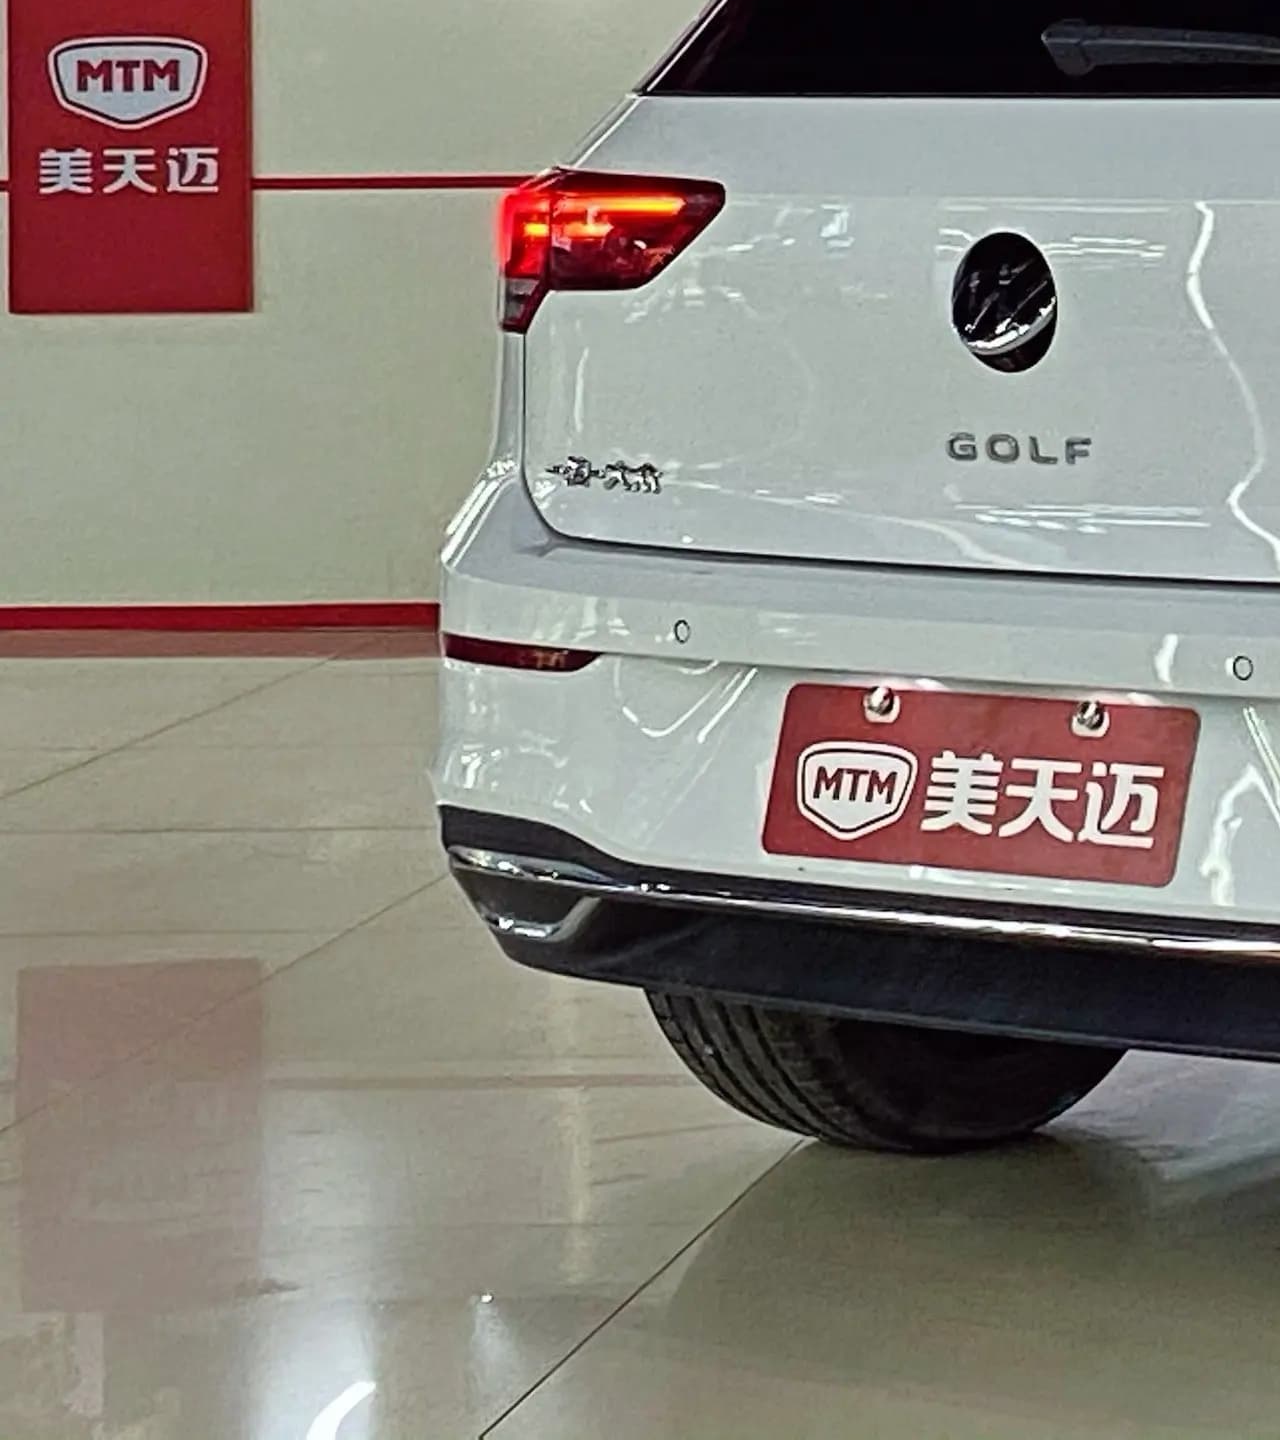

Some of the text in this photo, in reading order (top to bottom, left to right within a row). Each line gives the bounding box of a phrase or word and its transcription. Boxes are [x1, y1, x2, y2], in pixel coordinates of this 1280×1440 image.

[76, 59, 181, 92] MTM
[38, 146, 220, 195] 美天迈
[946, 432, 1092, 465] GOLF
[813, 765, 898, 805] MTM
[921, 751, 1165, 849] 美天迈
